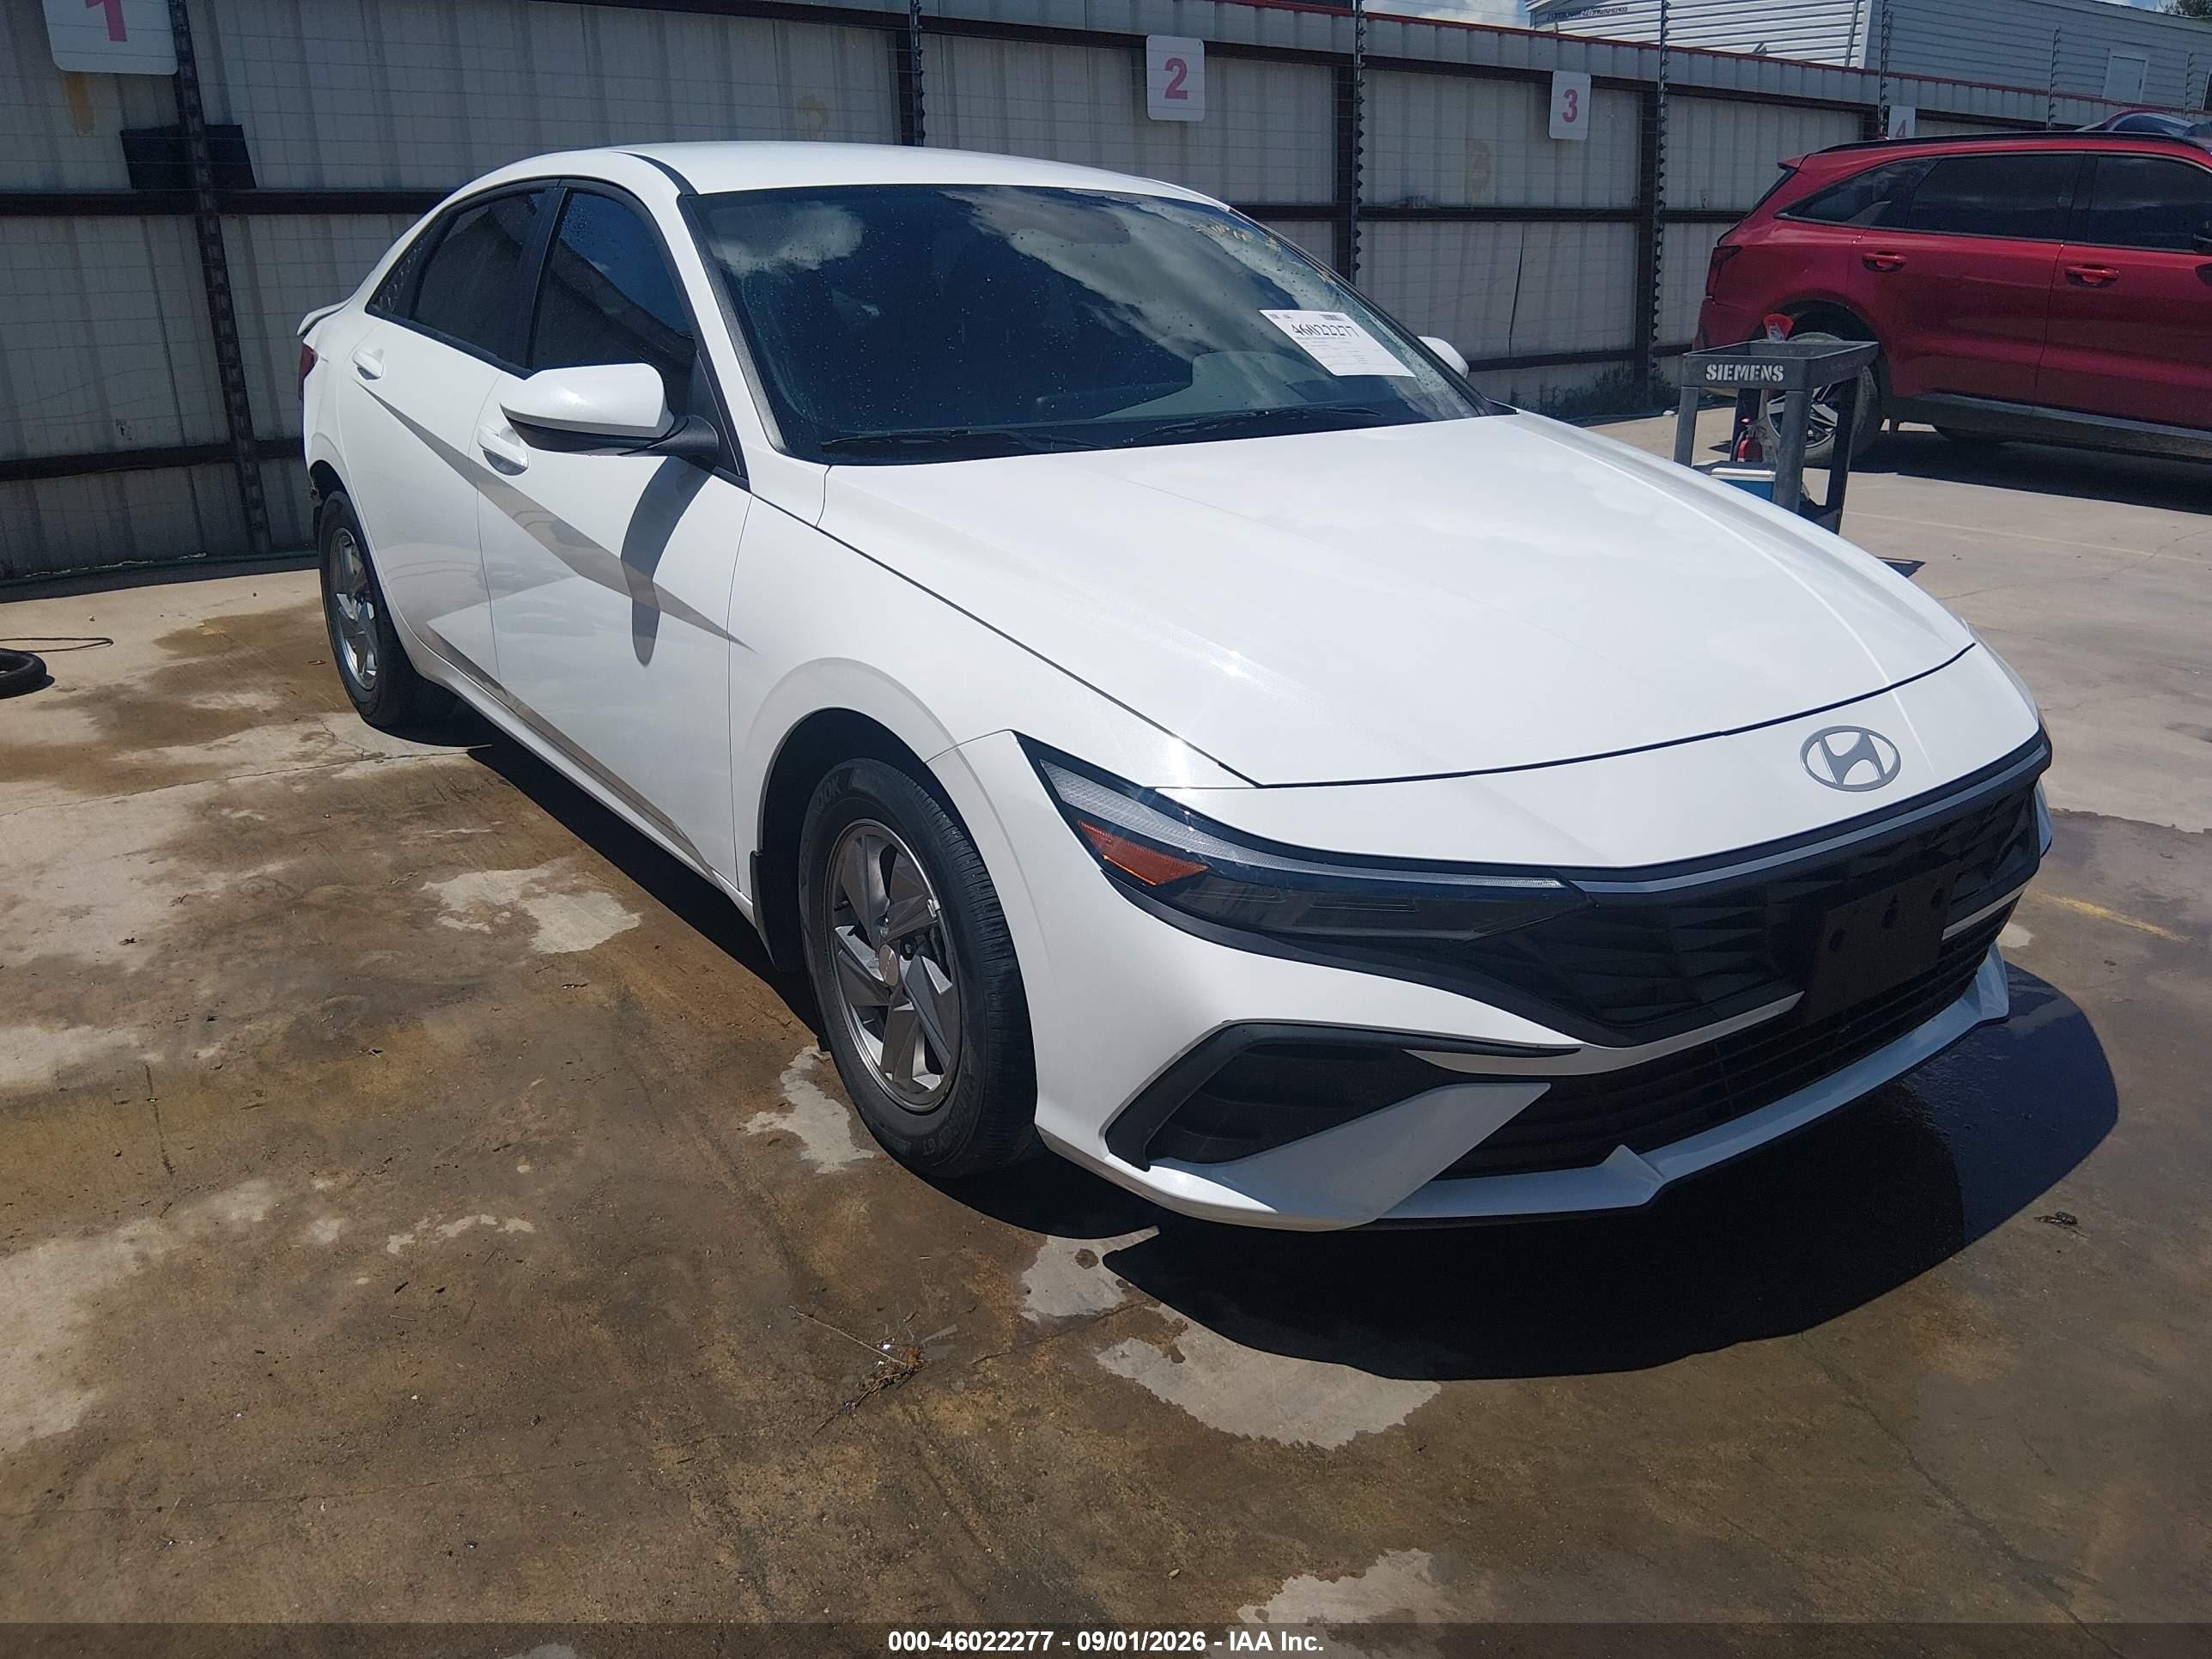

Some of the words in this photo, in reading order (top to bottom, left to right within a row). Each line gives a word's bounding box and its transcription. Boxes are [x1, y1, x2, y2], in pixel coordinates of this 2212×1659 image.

[85, 0, 127, 41] 1
[1164, 58, 1188, 100] 2
[1562, 88, 1578, 123] 3
[1895, 118, 1906, 138] 4
[1291, 323, 1360, 337] 46022277
[1705, 363, 1784, 382] SIEMENS
